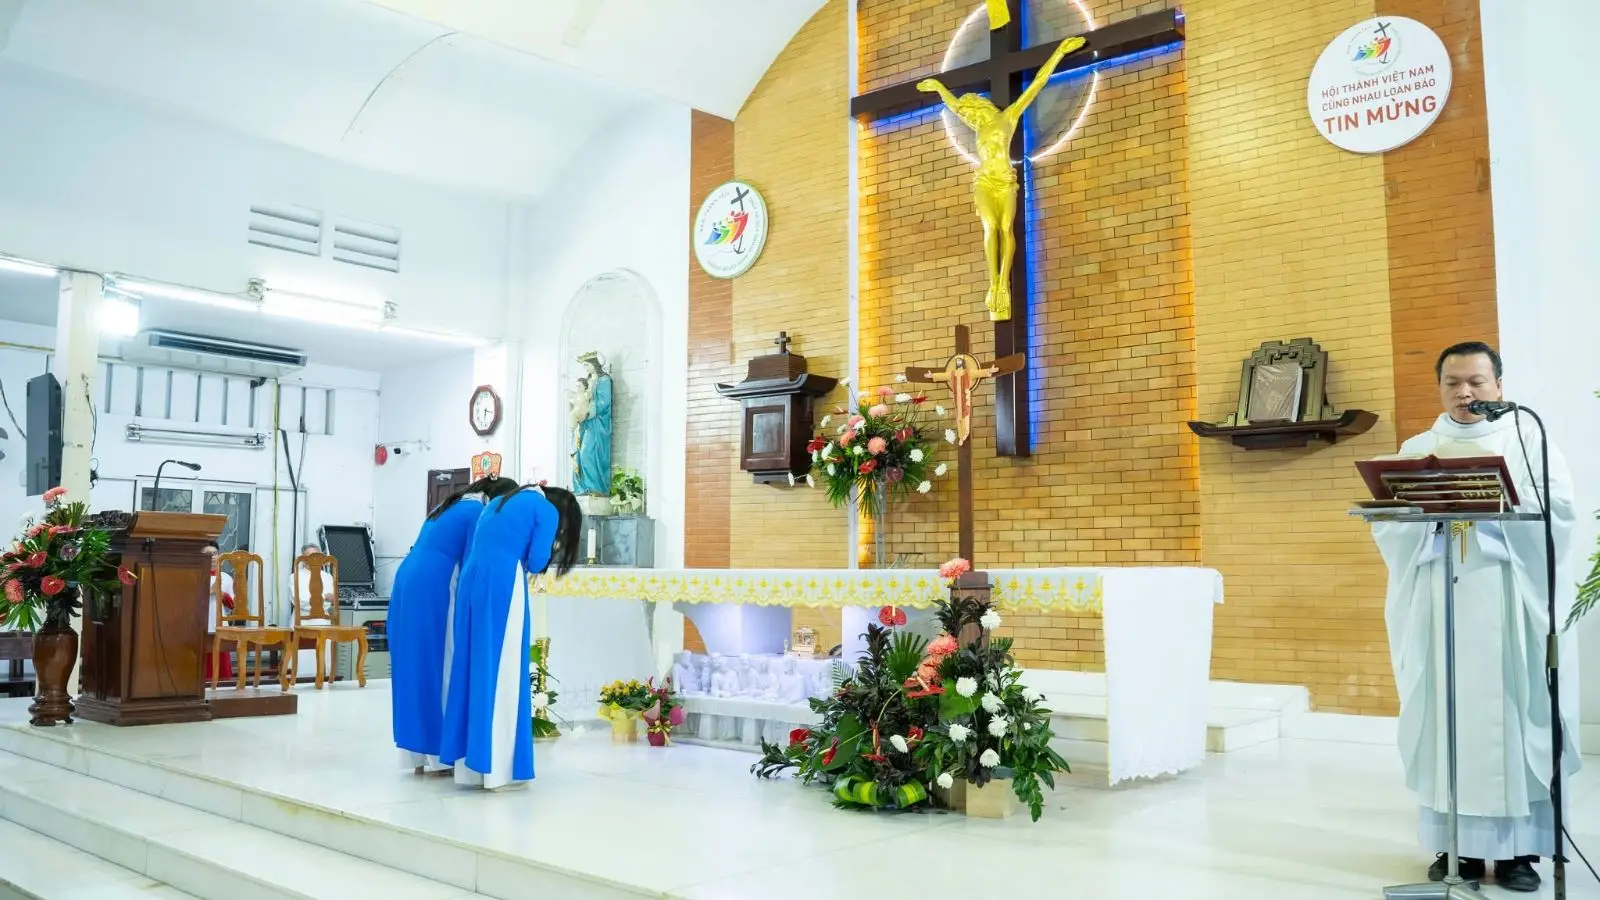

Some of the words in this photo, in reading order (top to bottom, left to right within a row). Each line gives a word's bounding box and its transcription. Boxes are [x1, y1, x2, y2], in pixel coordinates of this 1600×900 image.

[1408, 64, 1435, 78] NAM
[1352, 90, 1382, 105] NHAU
[1323, 112, 1360, 134] TIN
[1366, 95, 1437, 126] MỪNG
